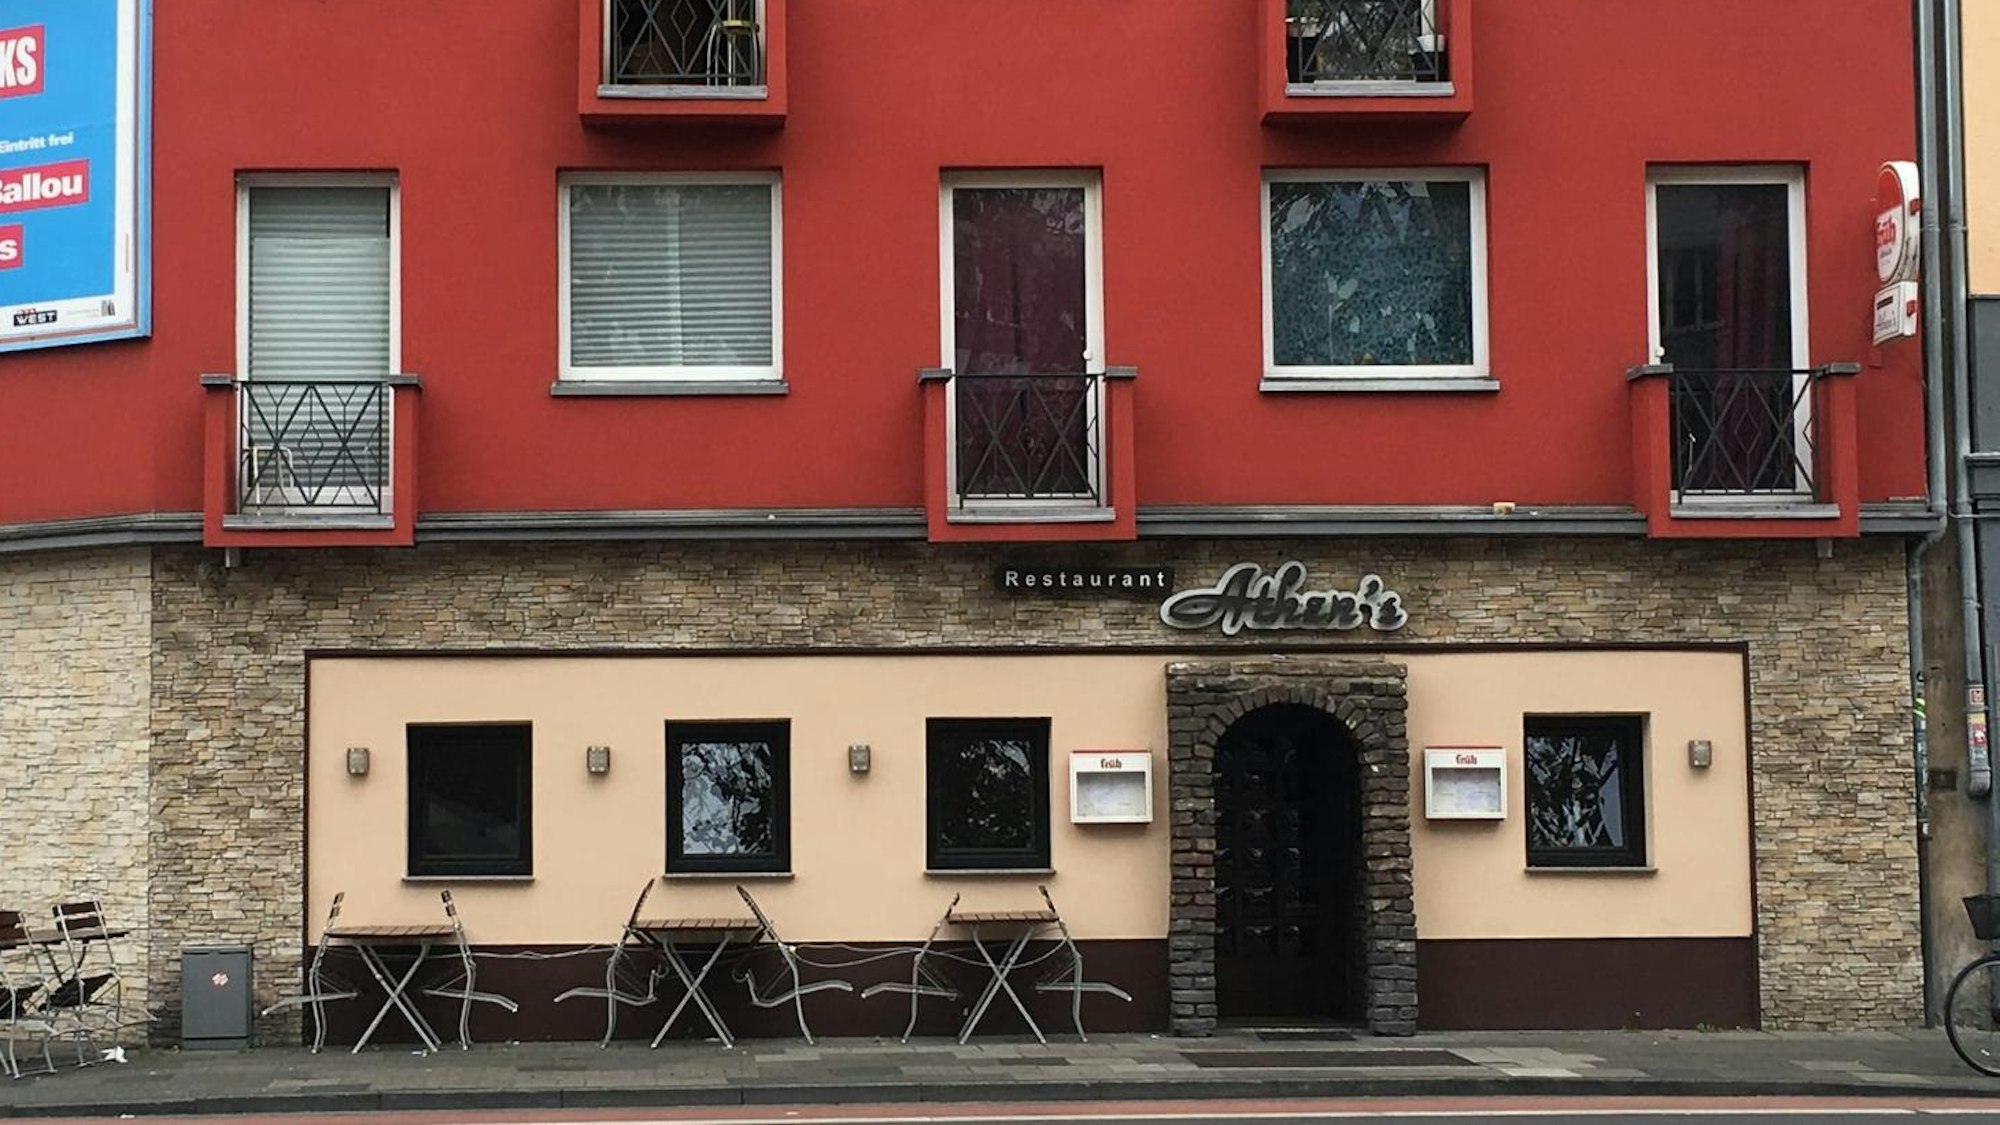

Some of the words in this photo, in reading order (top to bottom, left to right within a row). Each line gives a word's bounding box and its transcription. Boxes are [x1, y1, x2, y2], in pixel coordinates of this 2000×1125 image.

[48, 131, 74, 147] frei
[0, 171, 83, 205] allou
[1004, 570, 1167, 588] Restaurant
